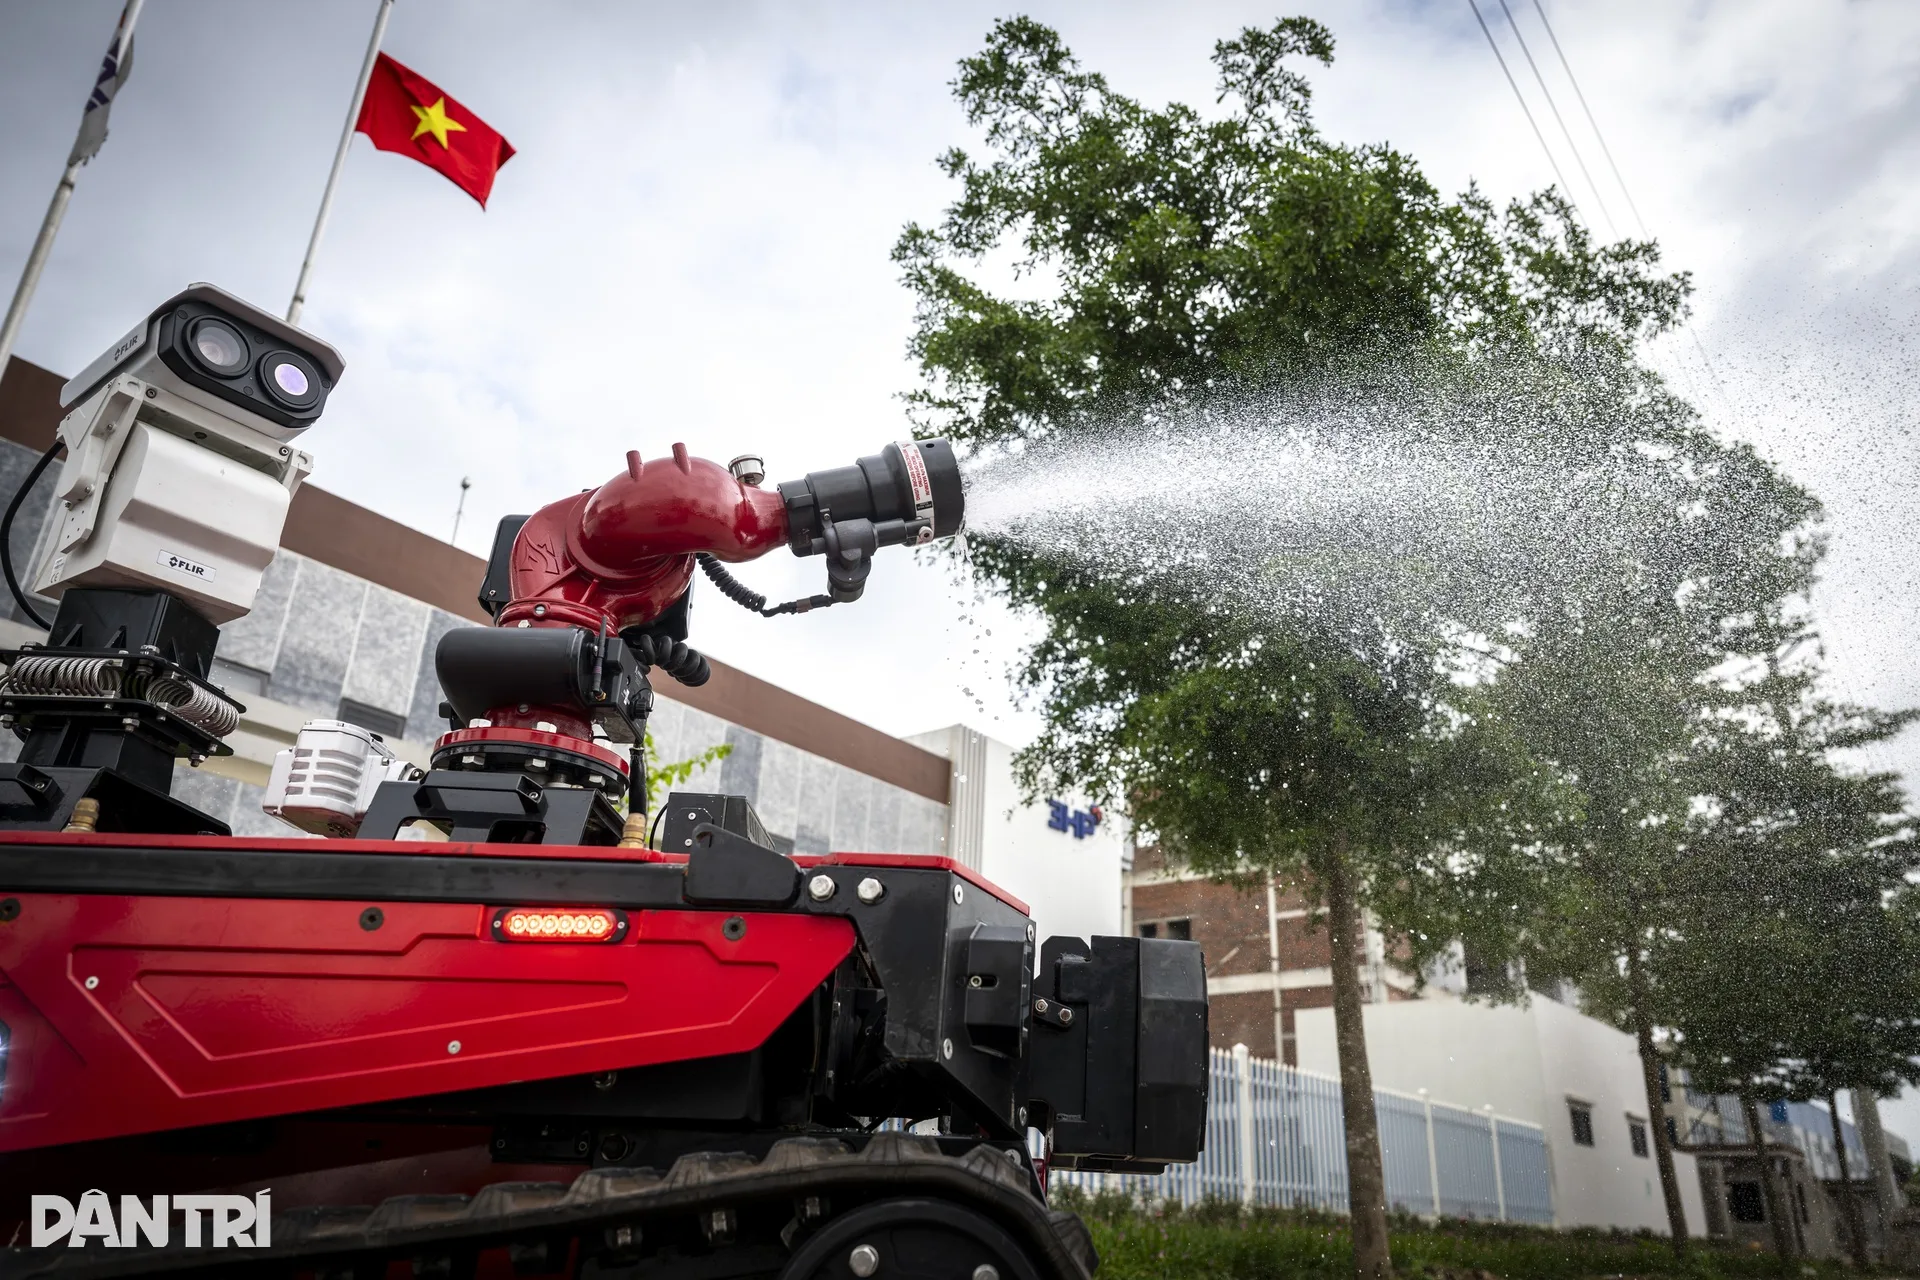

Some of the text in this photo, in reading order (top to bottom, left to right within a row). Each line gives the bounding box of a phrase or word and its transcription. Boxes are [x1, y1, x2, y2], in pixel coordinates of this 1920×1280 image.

[120, 335, 138, 355] FLIR
[910, 471, 918, 487] BEFORE
[913, 465, 923, 488] OPERATING
[922, 476, 930, 496] MAXIMUM
[178, 560, 205, 576] FLIR
